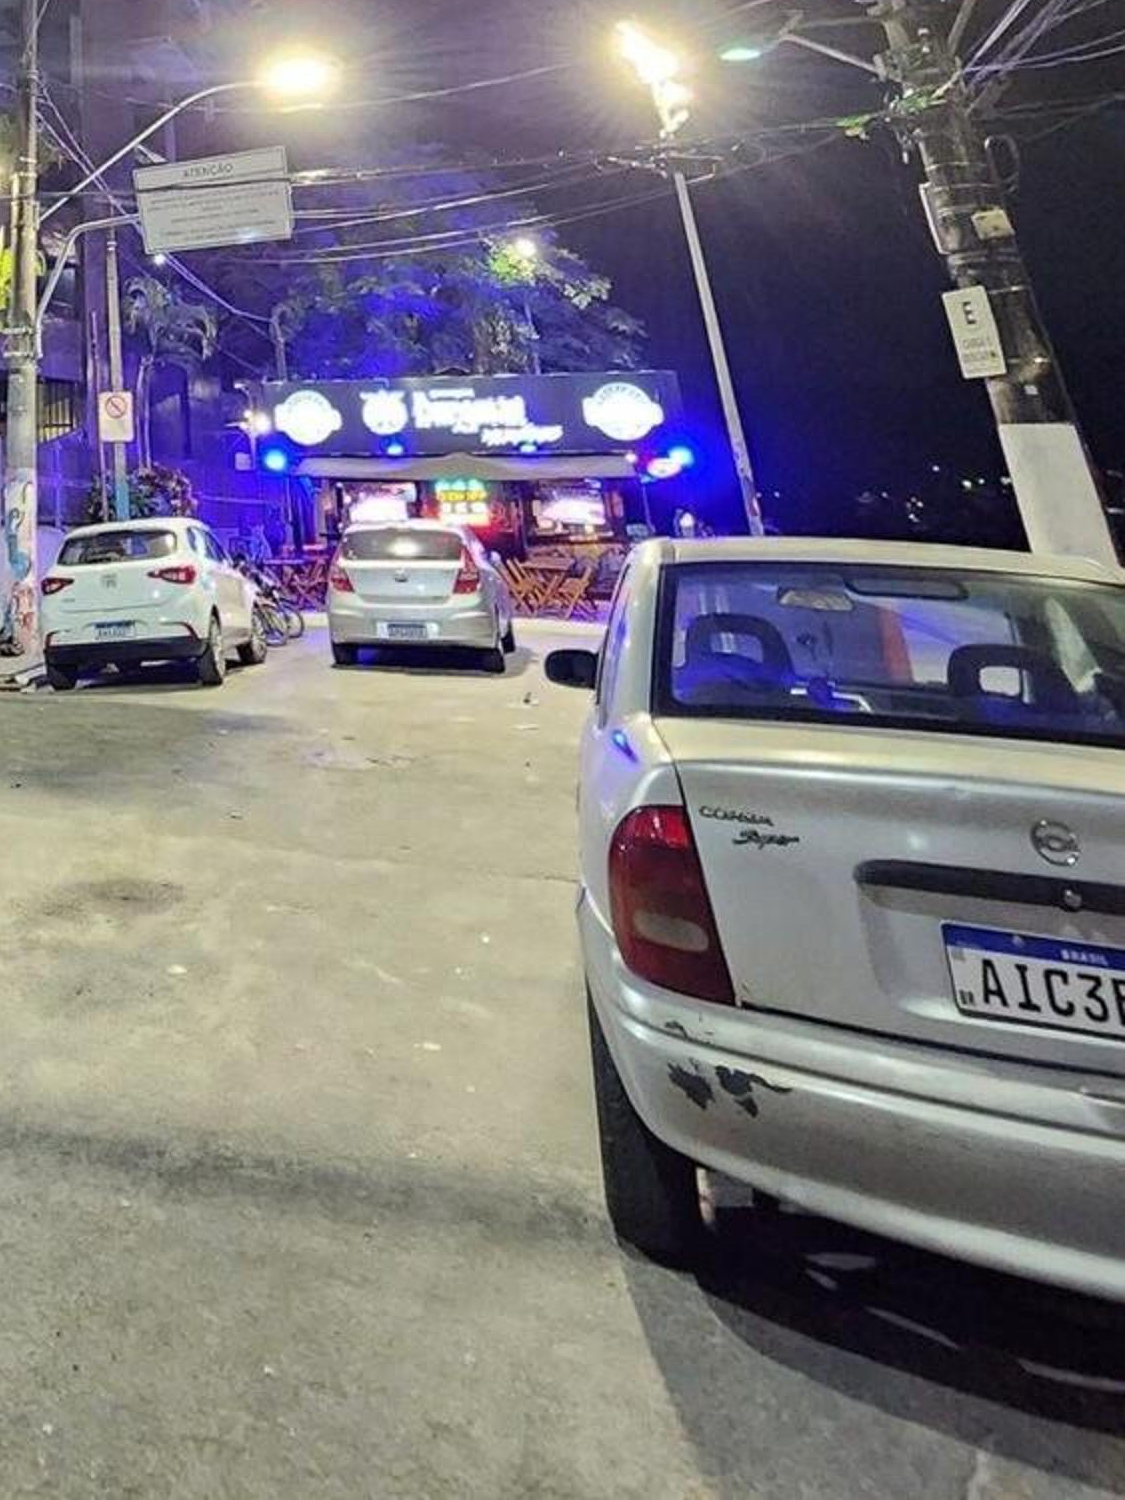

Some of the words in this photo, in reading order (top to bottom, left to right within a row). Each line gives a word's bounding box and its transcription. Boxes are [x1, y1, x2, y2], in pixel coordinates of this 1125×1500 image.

[183, 162, 233, 178] ATENÇÃO
[962, 301, 977, 325] E
[1060, 949, 1109, 967] BRASIL
